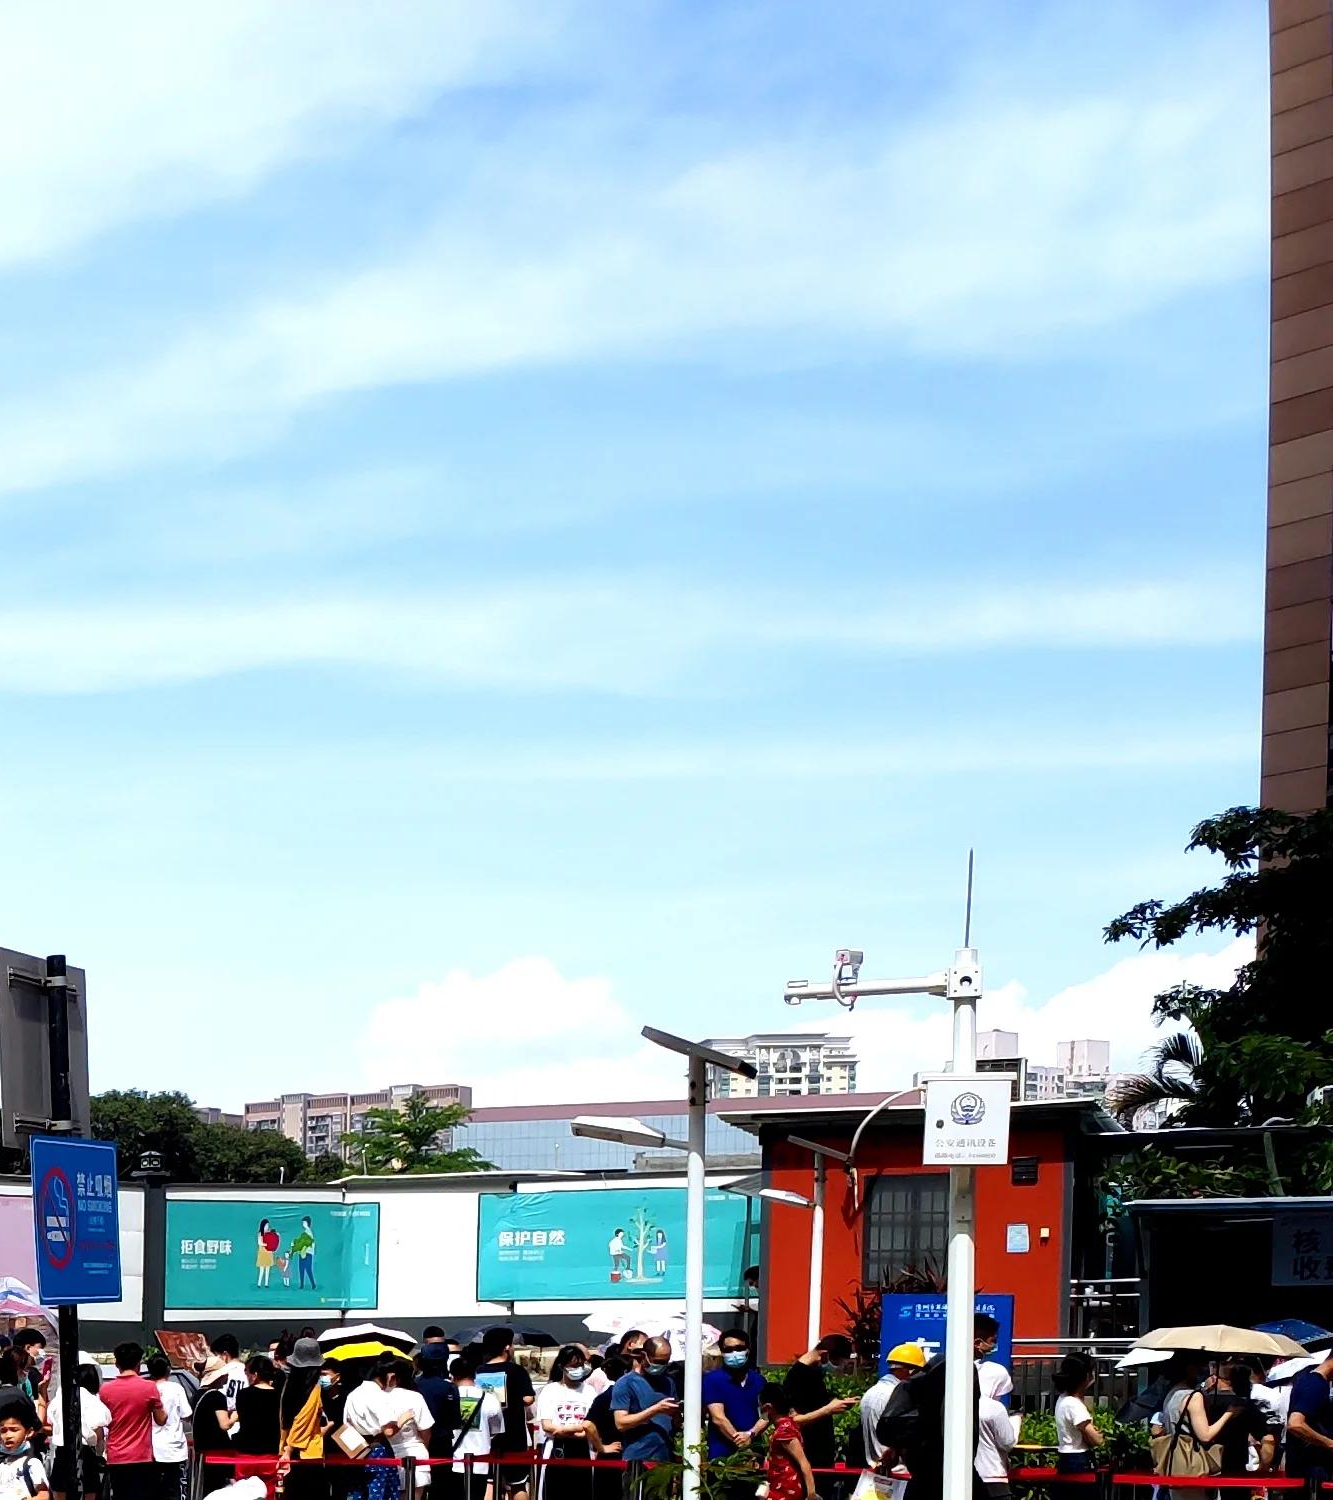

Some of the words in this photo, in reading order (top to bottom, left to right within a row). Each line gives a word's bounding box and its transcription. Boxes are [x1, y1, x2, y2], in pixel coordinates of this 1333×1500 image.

[77, 1171, 113, 1199] 禁止吸烟
[180, 1239, 232, 1255] 拒食野味
[498, 1229, 566, 1247] 保护自然
